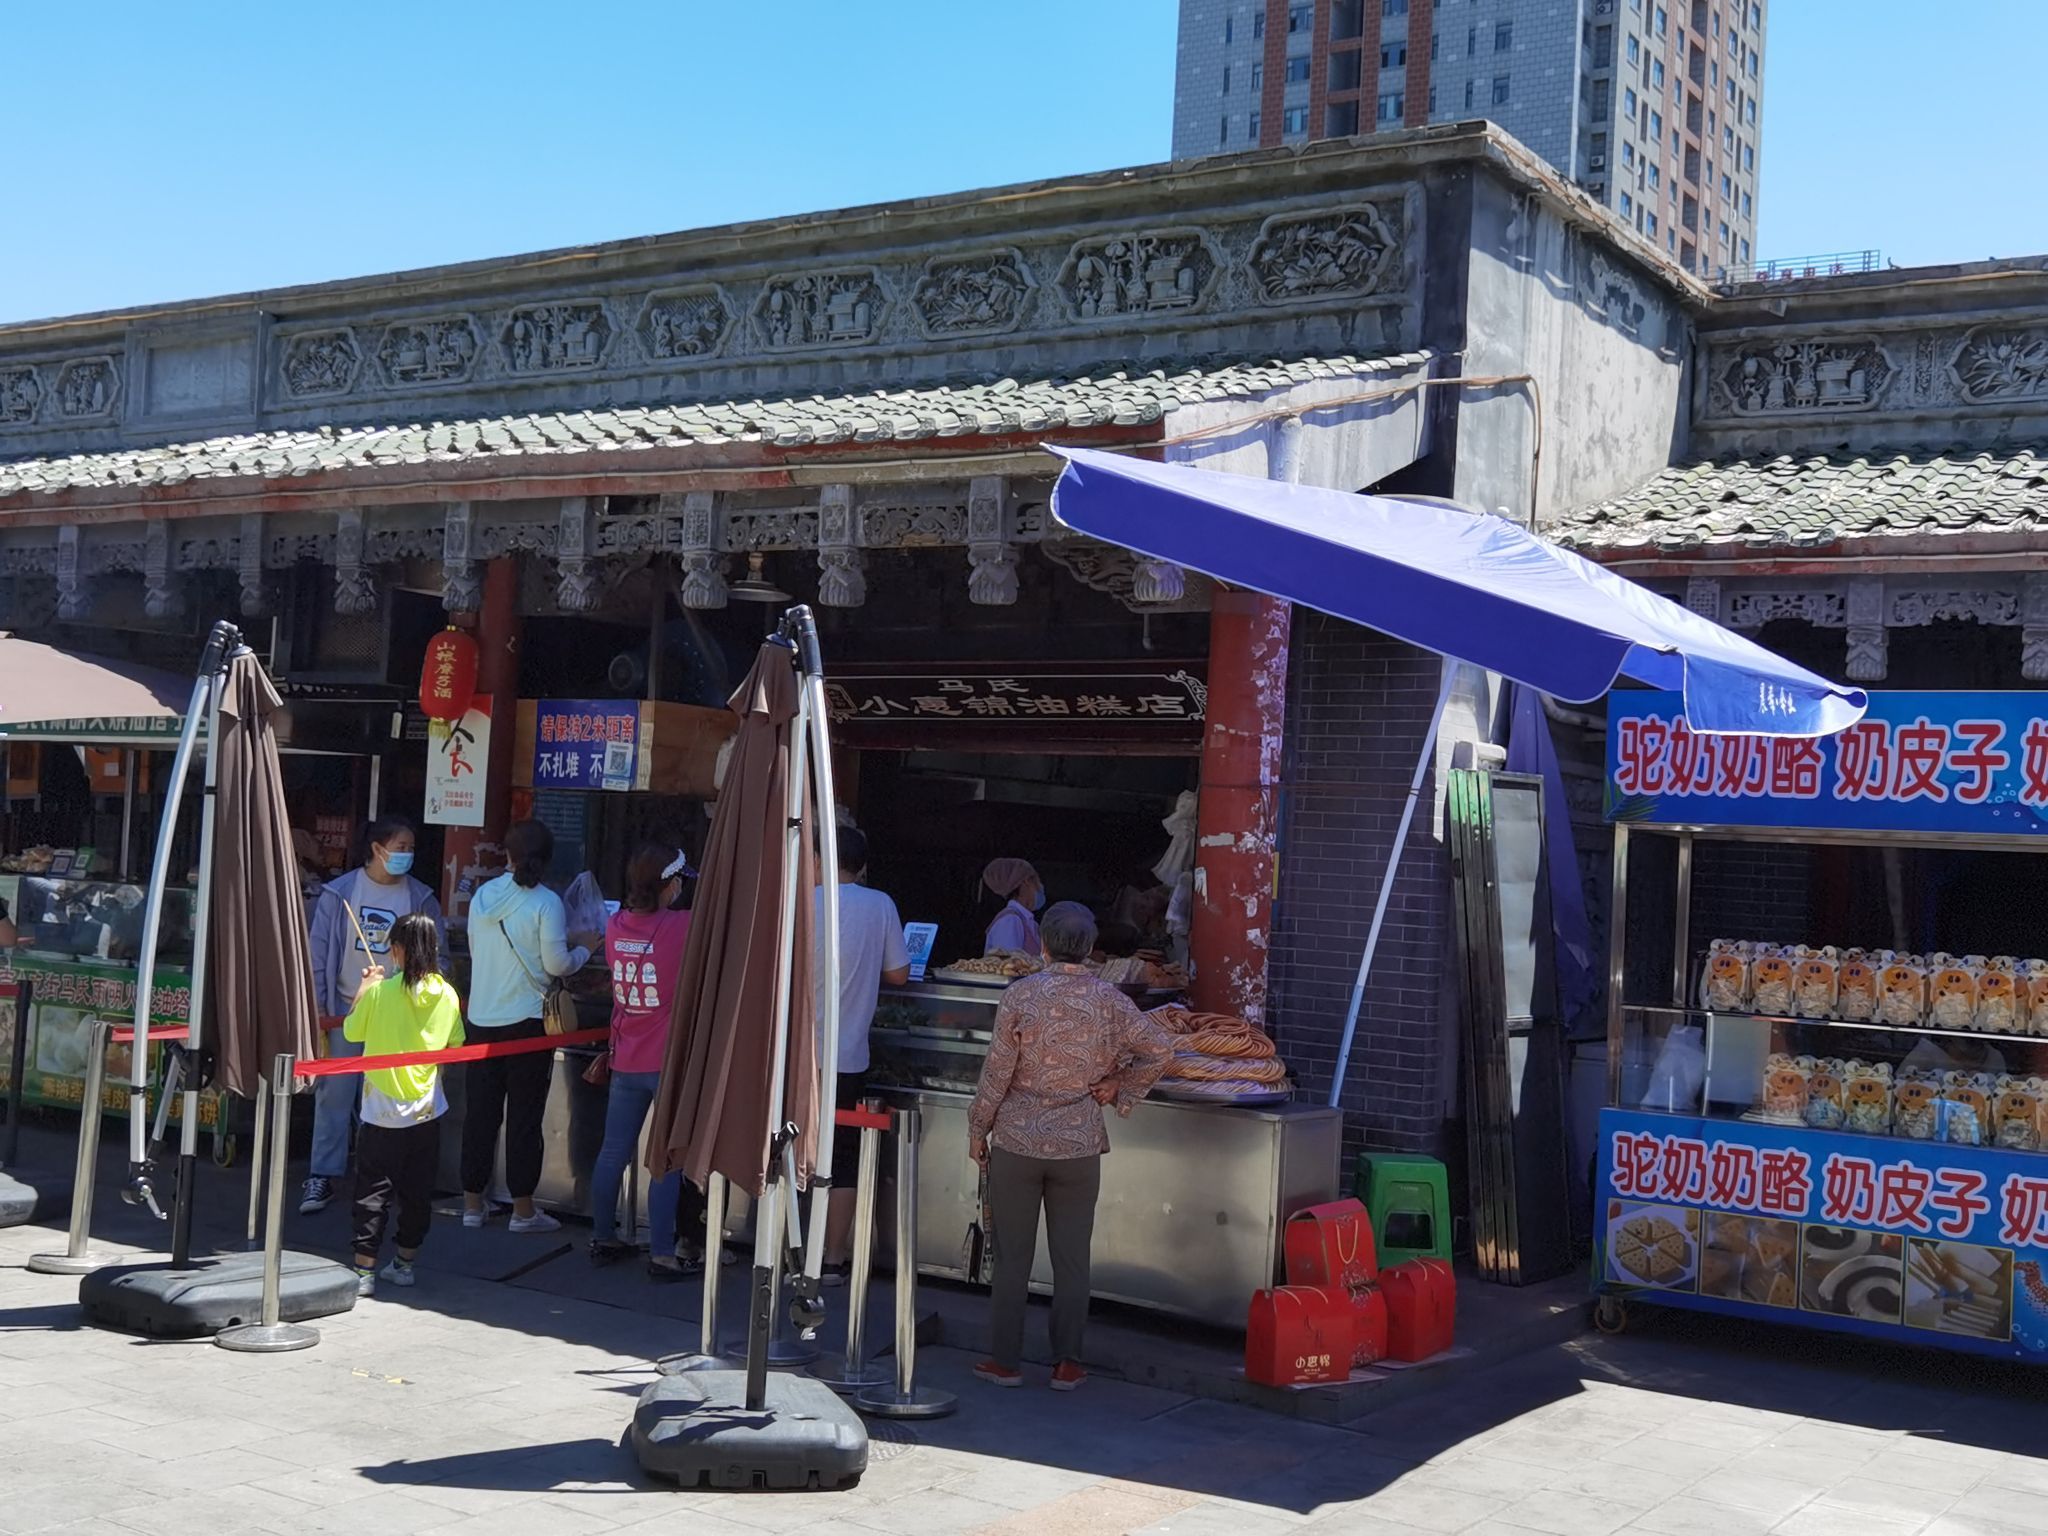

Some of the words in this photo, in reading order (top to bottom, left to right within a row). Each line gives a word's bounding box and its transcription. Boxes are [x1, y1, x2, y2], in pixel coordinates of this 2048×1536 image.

[541, 714, 635, 743] 请保持2米距离
[539, 751, 580, 779] 不扎堆
[1614, 714, 1825, 799] 驼奶奶酪
[1834, 714, 2010, 804] 奶皮子
[1611, 1131, 1812, 1216] 驼奶奶酪
[1823, 1152, 1992, 1236] 奶皮子
